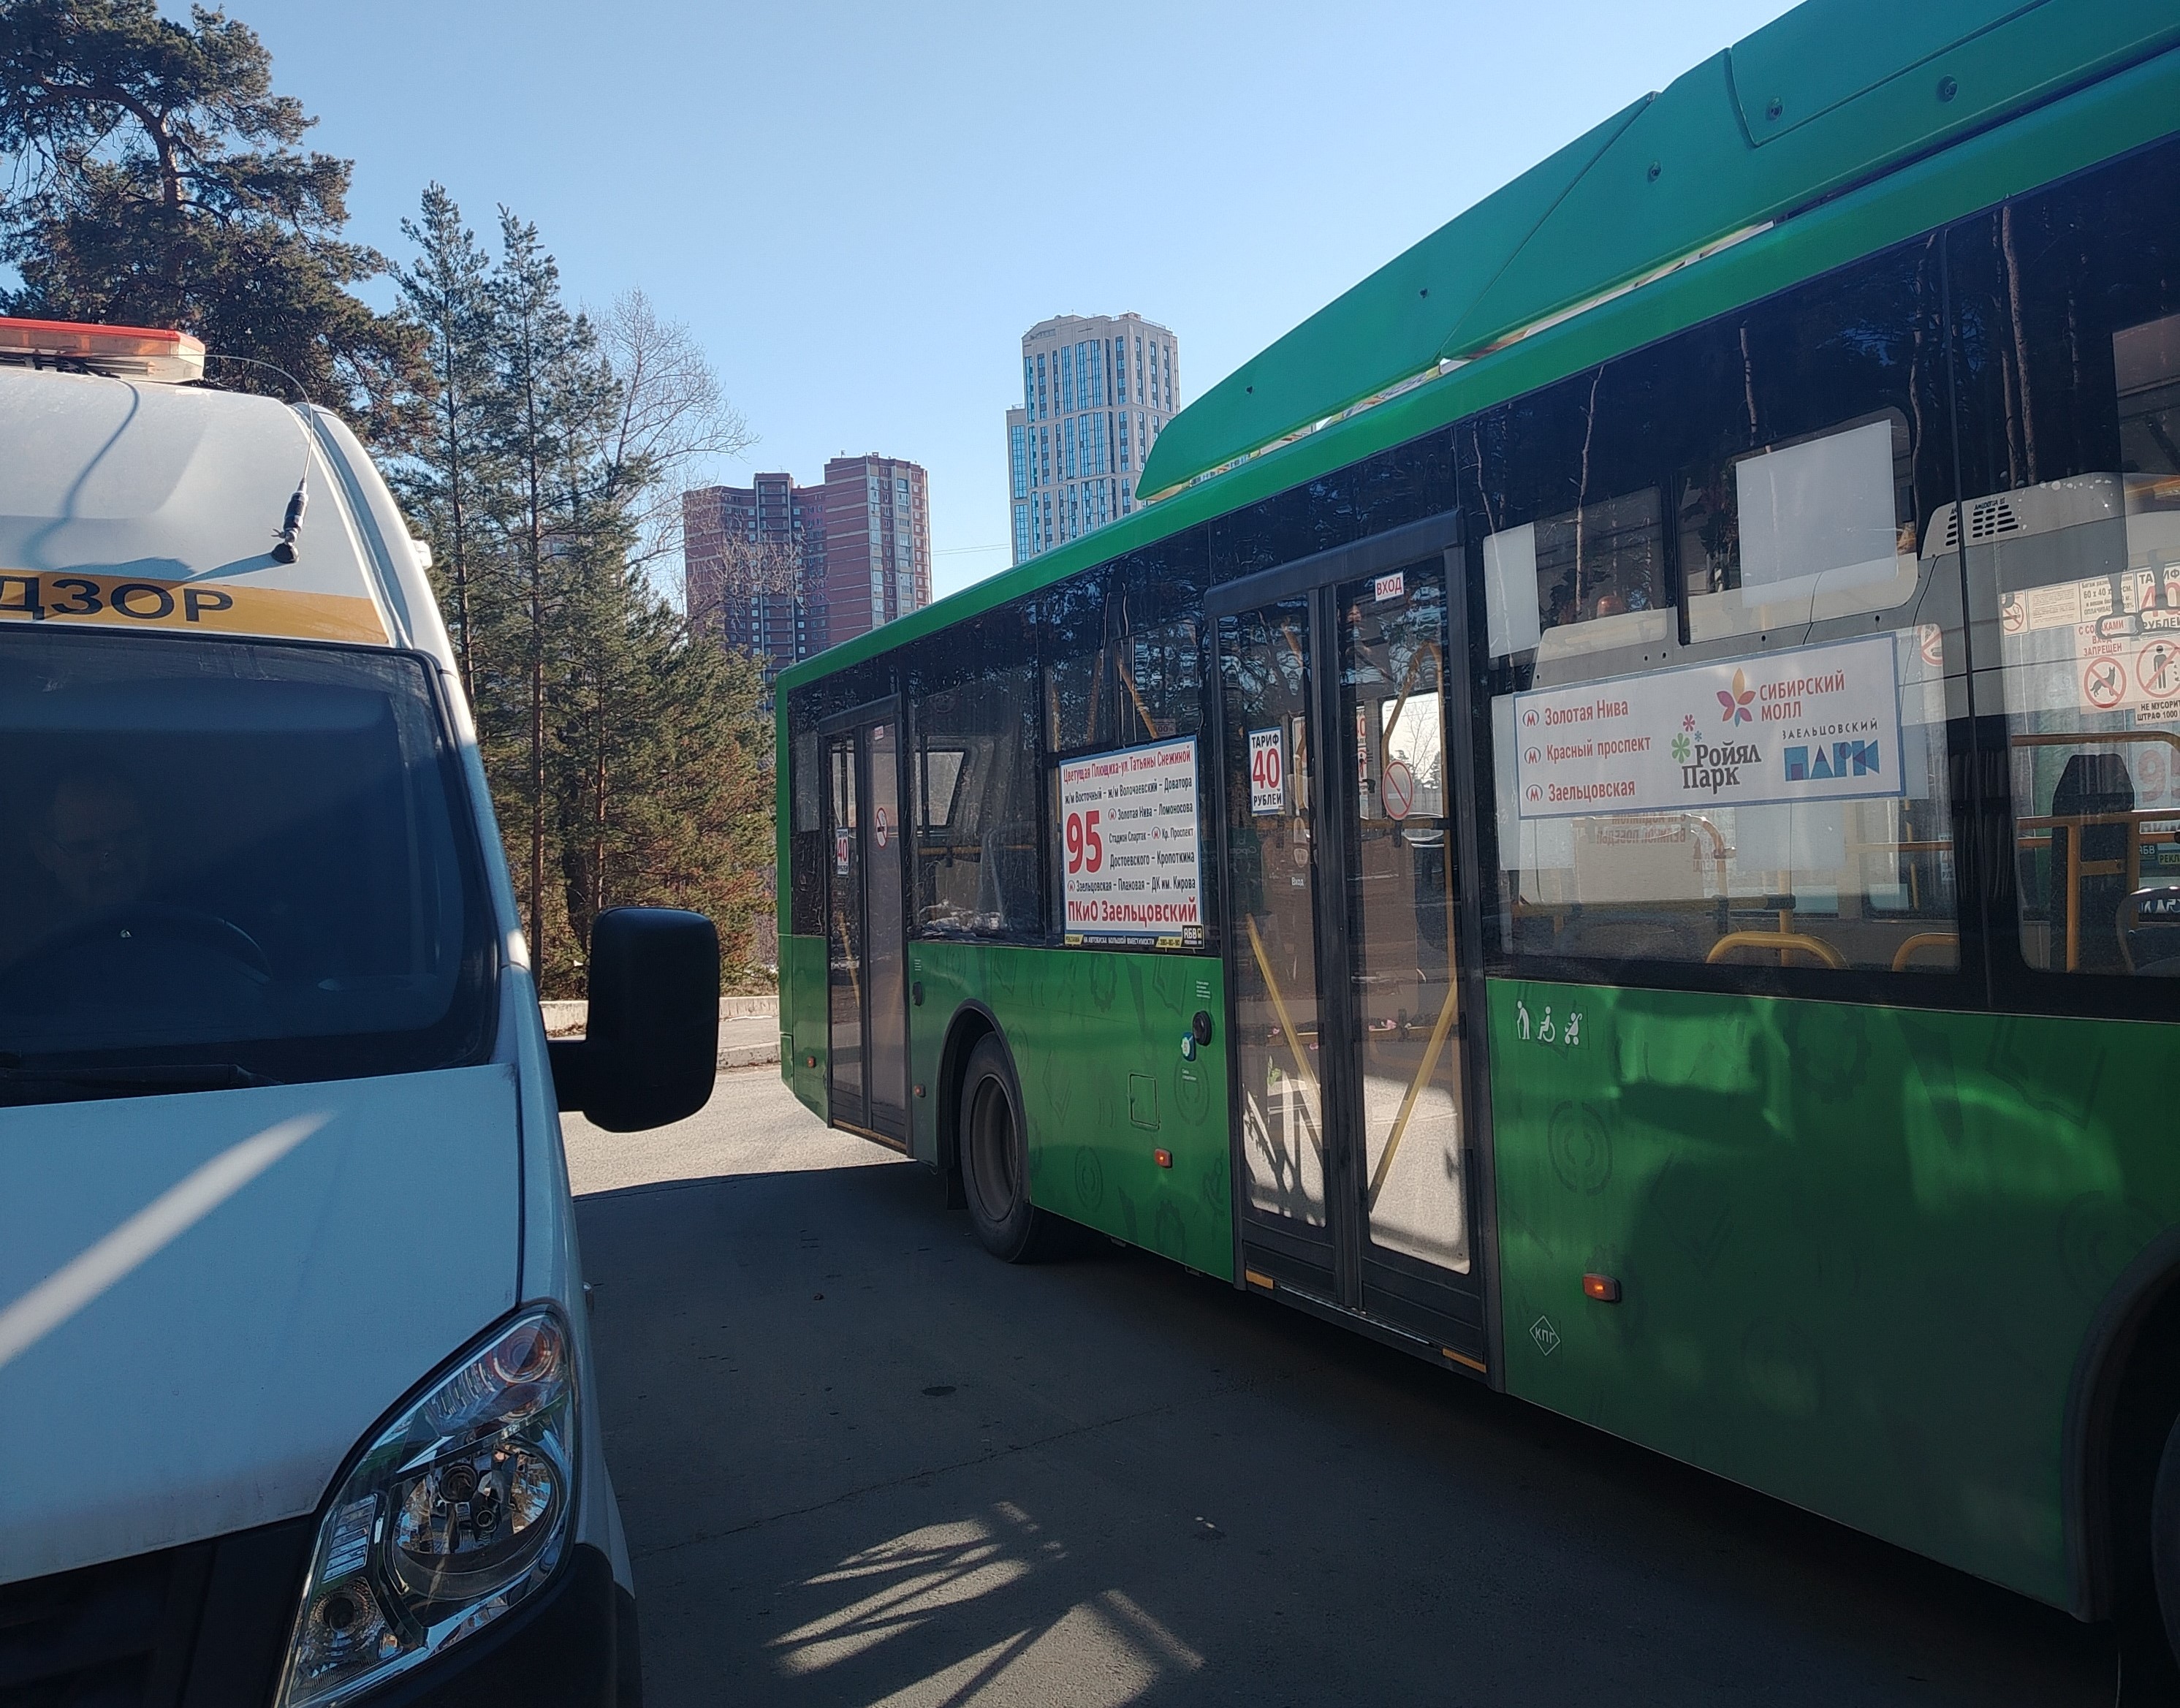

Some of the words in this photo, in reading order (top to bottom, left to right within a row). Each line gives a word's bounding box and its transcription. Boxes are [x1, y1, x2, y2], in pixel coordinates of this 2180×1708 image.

[1376, 577, 1402, 596] ВХОД
[2138, 569, 2180, 585] ТАИФ
[0, 575, 234, 623] ДЗОР
[2084, 590, 2091, 599] 60
[2098, 588, 2105, 596] 40
[2078, 626, 2084, 634] С
[2085, 620, 2124, 634] СОКАМИ
[2084, 642, 2122, 656] ЗАПРЕЩЕН
[1760, 669, 1845, 702] СИБИРСКИЙ
[1544, 705, 1593, 726] Золотая
[1597, 699, 1629, 718] Нива
[1761, 701, 1801, 721] МОЛЛ
[2137, 712, 2161, 721] ШТРАФ
[2162, 710, 2178, 718] 1000
[2141, 703, 2150, 711] НЕ
[1782, 718, 1878, 740] ЗАЕЛЬЦОВСКИЙ
[1251, 733, 1279, 749] ТАРИФ
[1546, 738, 1593, 764] Красный
[1598, 736, 1651, 759] проспект
[1694, 740, 1762, 767] Ройял
[1783, 739, 1880, 781] ПАРК
[1063, 767, 1090, 784] Цветущая
[1157, 745, 1190, 767] Снежиной
[1252, 748, 1280, 789] 40
[1682, 765, 1741, 794] Парк
[1065, 792, 1074, 804] ж/м
[1076, 786, 1102, 802] Восточный
[1108, 786, 1118, 799] ж/м
[1120, 778, 1158, 797] Волочаевский
[1164, 777, 1192, 793] Доватора
[1253, 788, 1282, 807] РУБЛЕЙ
[1548, 781, 1636, 803] Заельцовская
[1117, 808, 1138, 820] Золотая
[1139, 805, 1152, 817] Нива
[1158, 802, 1193, 816] Ломоносова
[1066, 810, 1103, 874] 95
[1109, 832, 1128, 845] Стадион
[1128, 831, 1147, 844] Спартак
[1162, 828, 1170, 841] Кр.
[1170, 827, 1193, 840] Проспект
[837, 838, 848, 862] 40
[1109, 854, 1150, 870] Достоевского
[1157, 851, 1195, 868] Кропоткина
[1076, 879, 1112, 894] Заельцовская
[1118, 878, 1145, 891] Плановая
[1152, 876, 1161, 892] ДК
[1161, 879, 1172, 889] им.
[1173, 876, 1196, 892] Кирова
[1068, 900, 1098, 922] ПКиО
[1101, 896, 1197, 927] Заельцовский
[1535, 1326, 1555, 1344] КПГ
